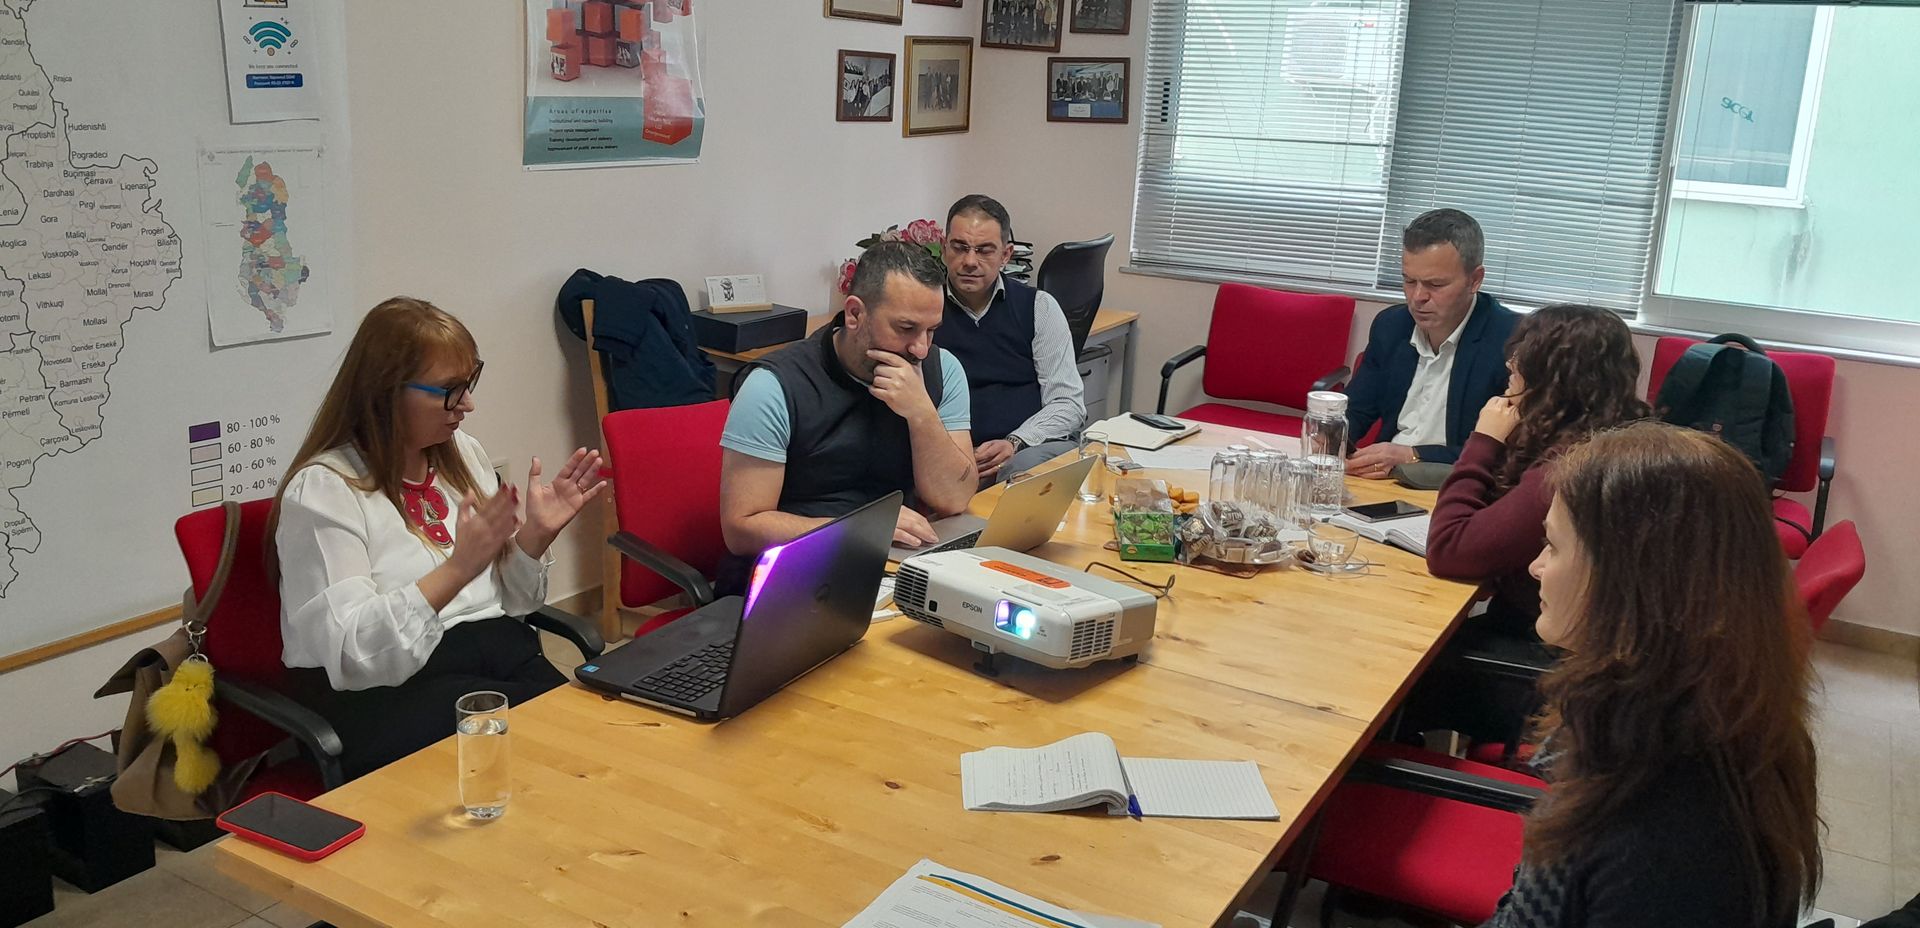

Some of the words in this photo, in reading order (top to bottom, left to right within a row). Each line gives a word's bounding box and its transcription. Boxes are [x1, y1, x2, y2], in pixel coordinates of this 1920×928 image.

[71, 151, 108, 160] Pogradeci
[0, 207, 19, 216] enia
[40, 215, 58, 223] Gora
[110, 221, 133, 231] Pojani
[65, 230, 87, 240] Maliqi
[42, 248, 79, 258] Voskopoja
[28, 271, 51, 280] Lekasi
[86, 287, 108, 297] Mollaj
[133, 290, 154, 298] Mirasi
[0, 314, 20, 322] otomi
[82, 317, 108, 326] Mollasi
[82, 361, 106, 370] Erseka
[59, 376, 93, 388] Barmashi
[19, 393, 46, 403] Petrani
[226, 421, 240, 433] 80
[250, 416, 268, 429] 100
[270, 414, 280, 424] %
[228, 442, 241, 453] 60
[250, 437, 263, 449] 80
[265, 435, 276, 445] %
[6, 457, 32, 469] Pogoni
[229, 463, 242, 474] 40
[251, 459, 264, 470] 60
[266, 456, 277, 466] %
[230, 484, 243, 496] 20
[252, 479, 265, 490] 40
[267, 477, 278, 487] %
[962, 601, 983, 614] EPSON
